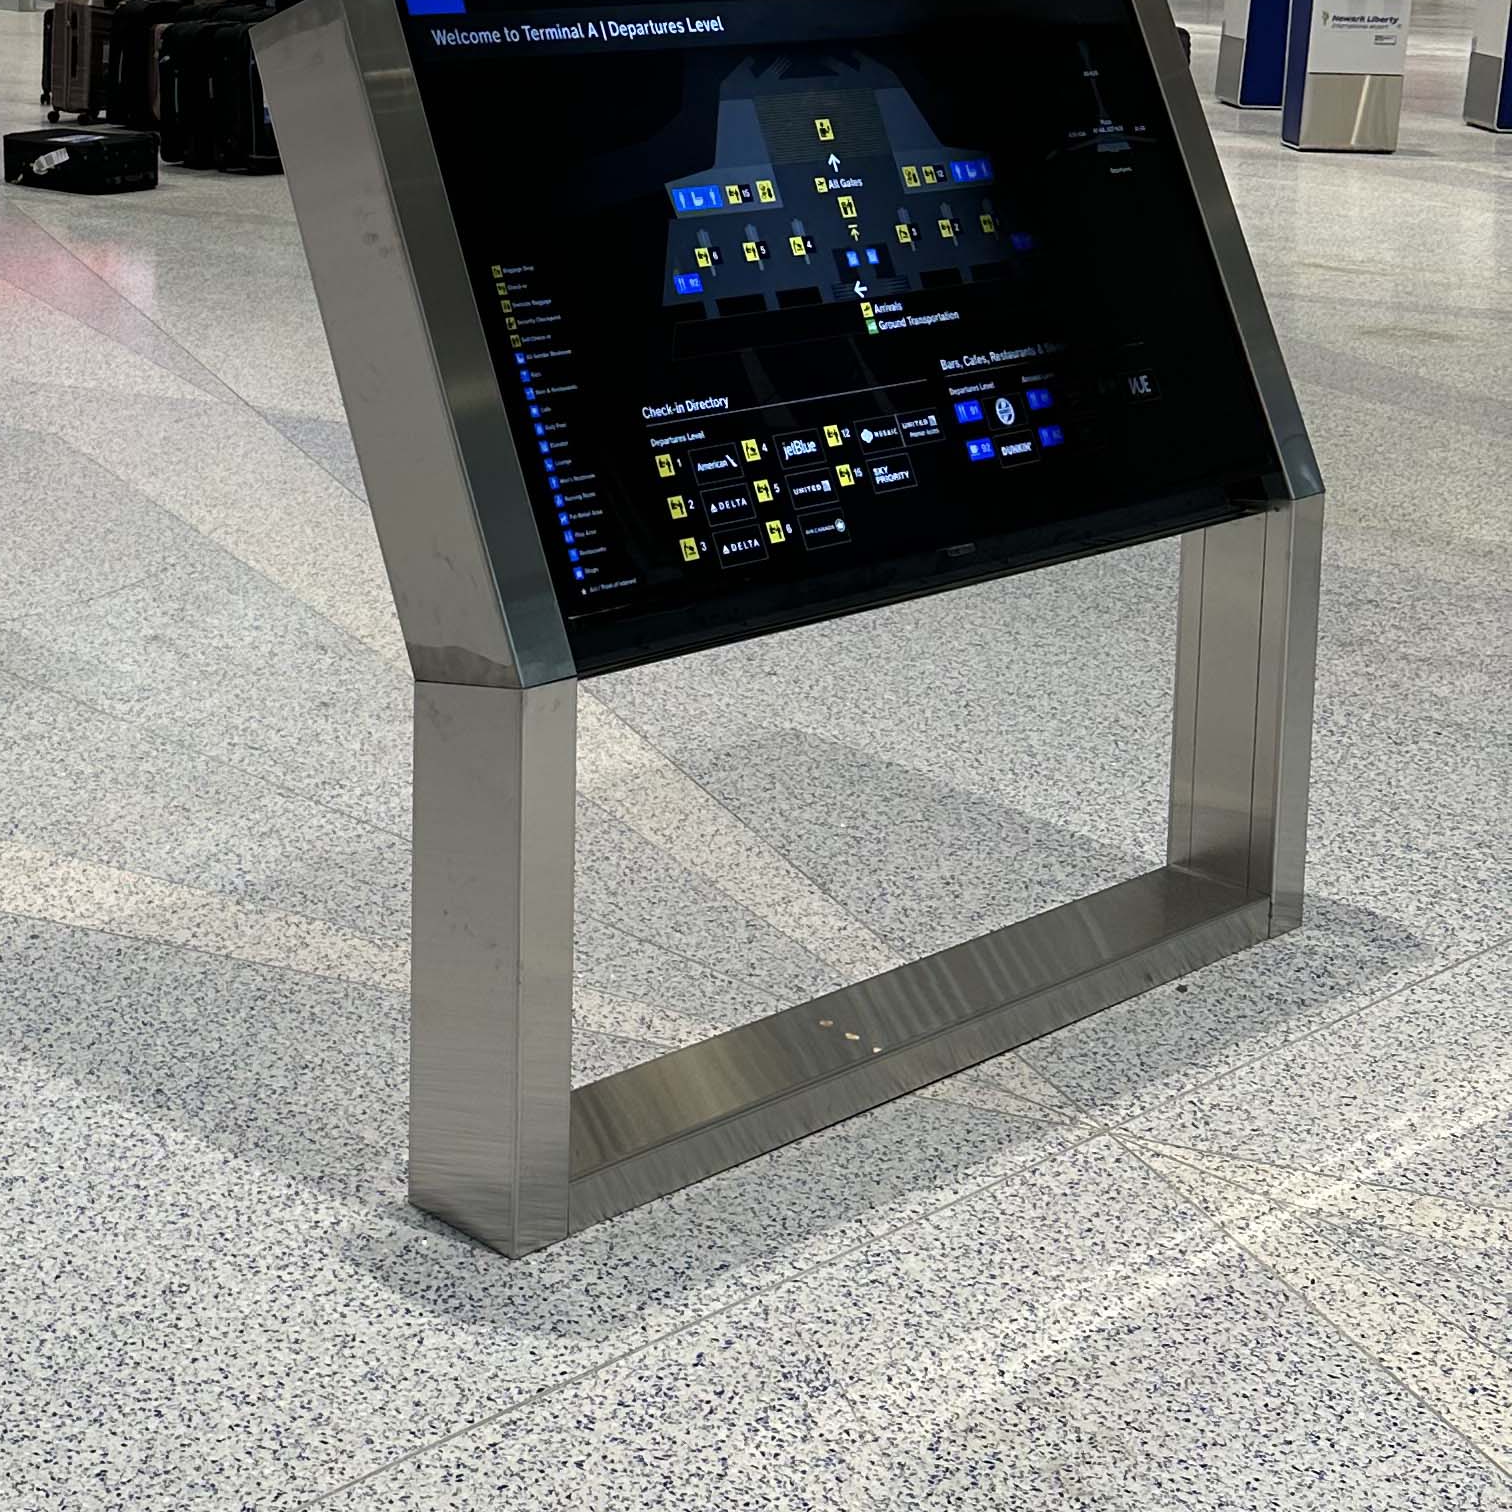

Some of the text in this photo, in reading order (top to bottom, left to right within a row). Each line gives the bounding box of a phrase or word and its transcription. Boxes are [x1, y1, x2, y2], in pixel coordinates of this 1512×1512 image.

[1332, 15, 1399, 25] Newark Liberty
[431, 27, 501, 46] Welcome
[503, 28, 520, 42] to
[521, 23, 585, 41] Terminal
[587, 22, 600, 39] A
[608, 19, 685, 40] Departures
[686, 15, 725, 34] Level
[828, 177, 863, 190] All Gates
[759, 245, 767, 255] 5
[805, 240, 813, 249] 4
[874, 301, 903, 315] Arrivals
[878, 311, 960, 331] Ground Transportation
[641, 396, 729, 419] Check-in Directory
[650, 430, 706, 448] Departures Level
[841, 428, 851, 438] 12
[761, 442, 769, 453] 4
[782, 439, 817, 460] jetBlue
[697, 459, 729, 472] American
[872, 465, 889, 477] SKY
[875, 470, 910, 485] PRIORITY
[773, 483, 781, 494] 5
[793, 483, 822, 496] UNITED
[688, 499, 695, 510] 2
[718, 497, 748, 512] DELTA
[785, 523, 793, 534] 6
[700, 541, 708, 552] 3
[730, 538, 761, 552] DELTA
